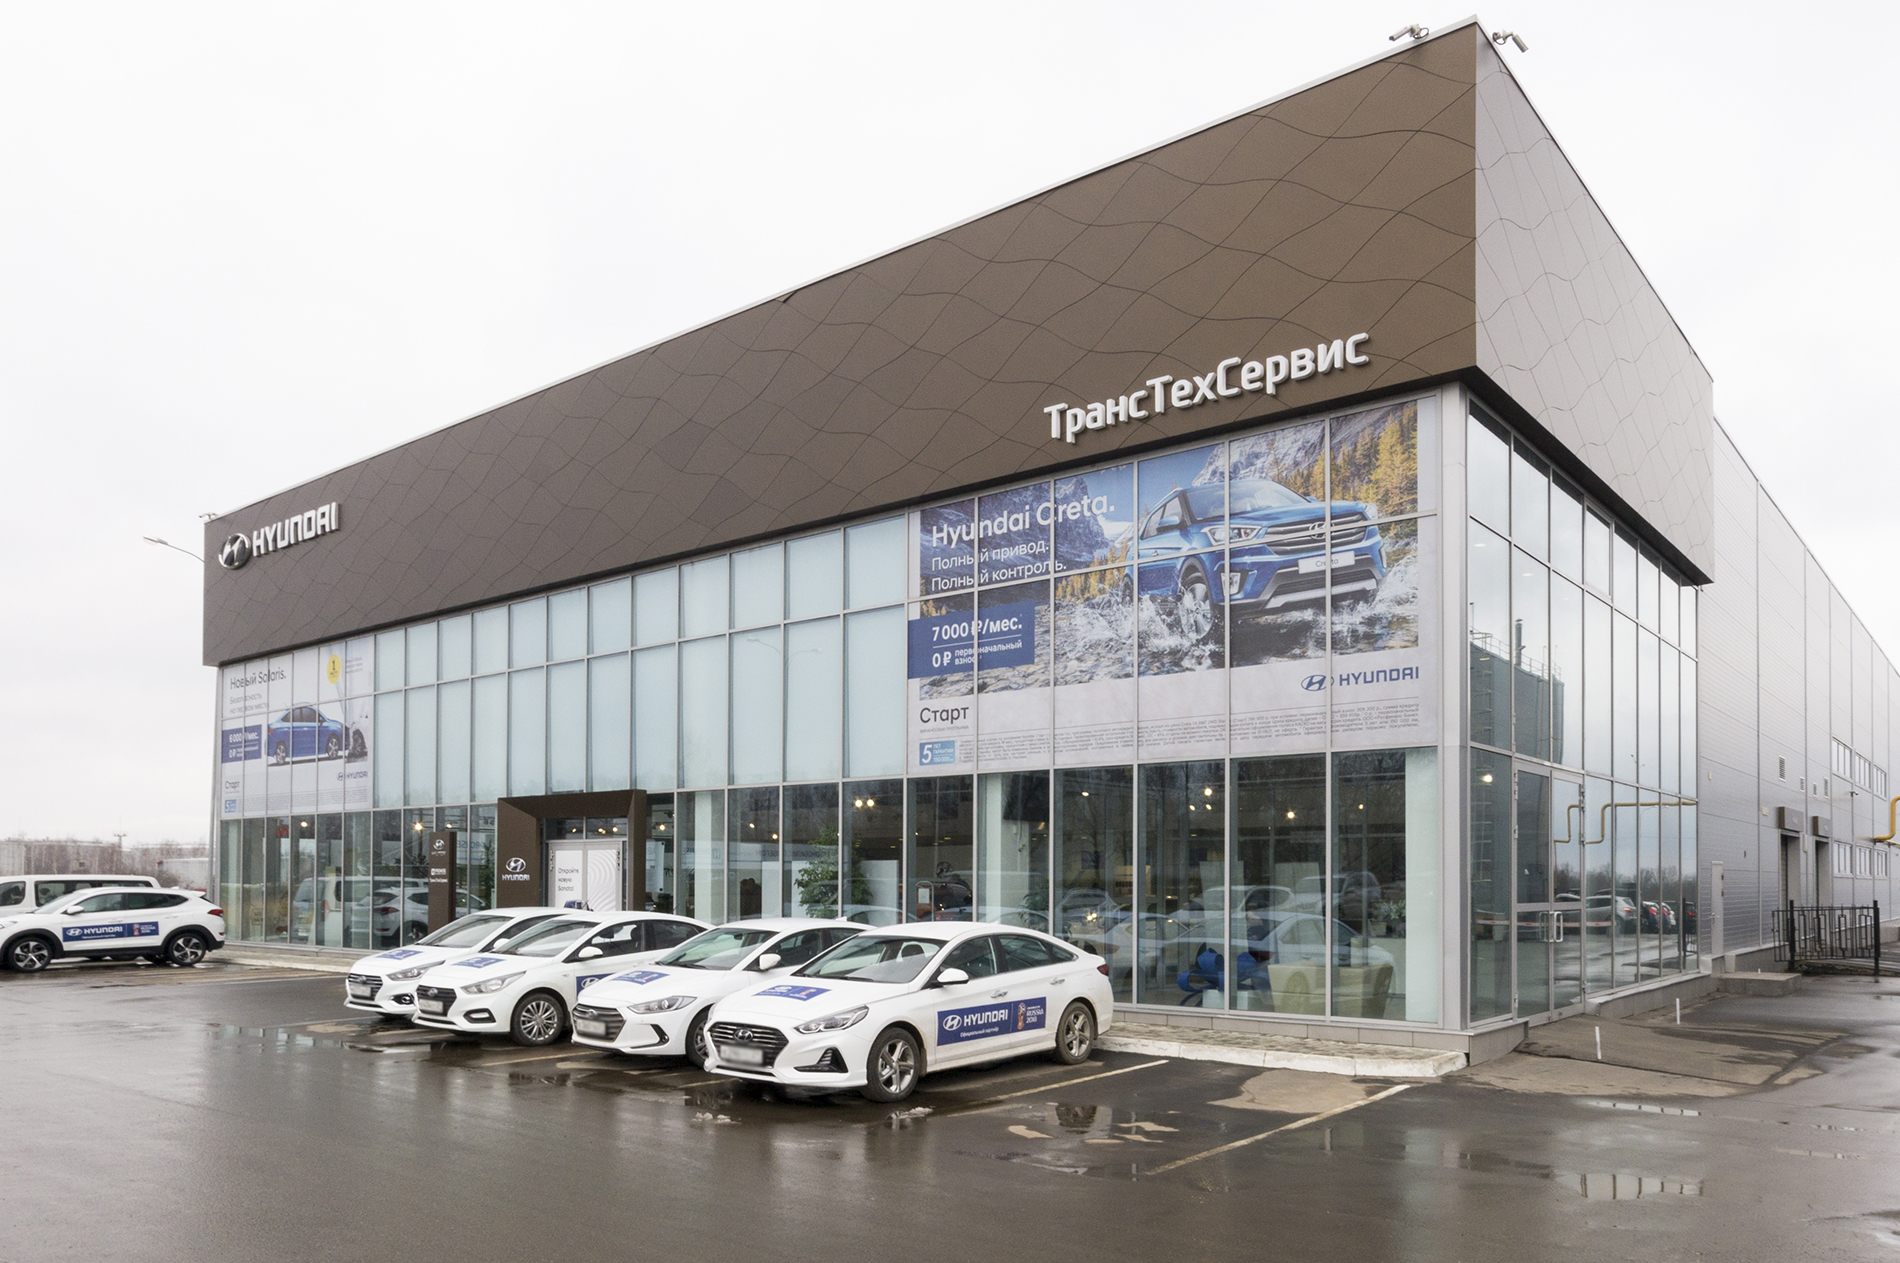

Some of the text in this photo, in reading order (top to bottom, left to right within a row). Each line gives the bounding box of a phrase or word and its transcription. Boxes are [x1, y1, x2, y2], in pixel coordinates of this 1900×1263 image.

[1043, 332, 1370, 444] ТрансТехСервис
[252, 502, 341, 557] HYUNDAI
[932, 494, 1115, 549] Hyundai Creta.
[931, 539, 1049, 572] Полный привод.
[931, 560, 1067, 592] Полный контроль.
[932, 653, 941, 668] 0
[954, 639, 1022, 657] первоначальный
[230, 672, 257, 690] Новый
[1339, 666, 1419, 686] HYUNDAI
[920, 707, 969, 724] Старт
[922, 744, 933, 764] 5
[346, 770, 368, 779] HYUNDAI
[84, 926, 123, 935] HYUNDAI
[964, 1009, 1009, 1026] HYUNDAI
